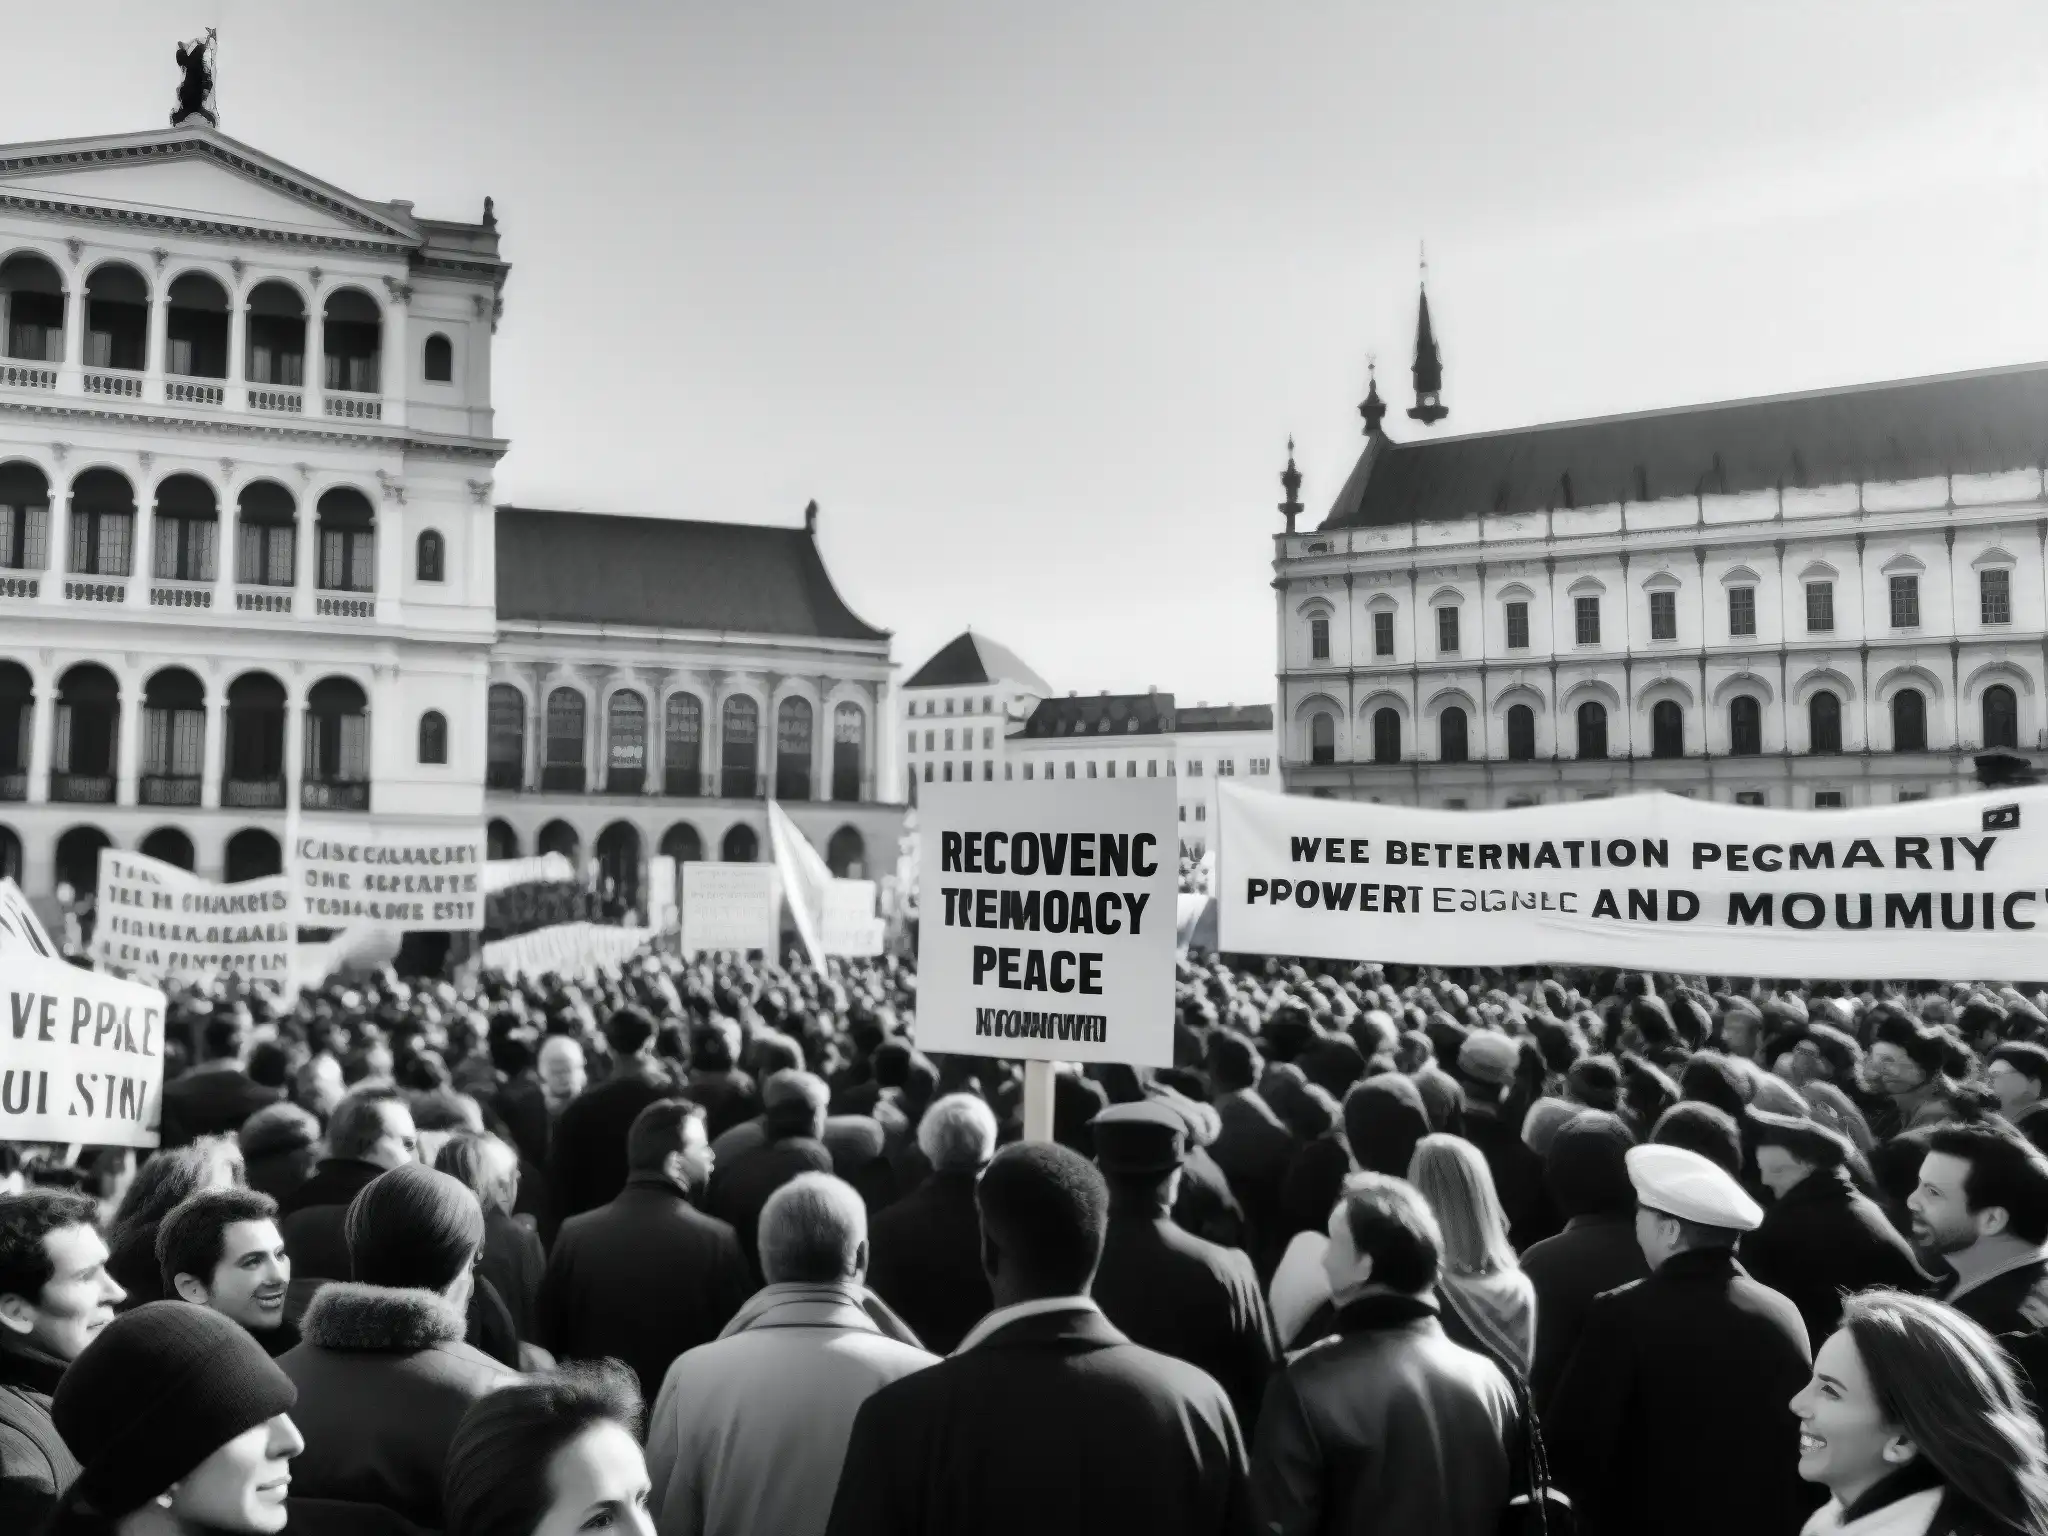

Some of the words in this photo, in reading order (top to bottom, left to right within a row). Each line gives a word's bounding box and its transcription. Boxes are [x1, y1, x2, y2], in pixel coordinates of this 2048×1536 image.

[941, 830, 1159, 877] RECOVENC
[1291, 836, 1370, 864] WEE
[1385, 838, 1669, 870] BETERNATION
[1692, 836, 1998, 873] PEGMARIY
[1591, 888, 1701, 922] AND
[1726, 889, 2048, 931] MOUMUIC
[972, 945, 1103, 995] PEACE
[10, 991, 58, 1042] VE
